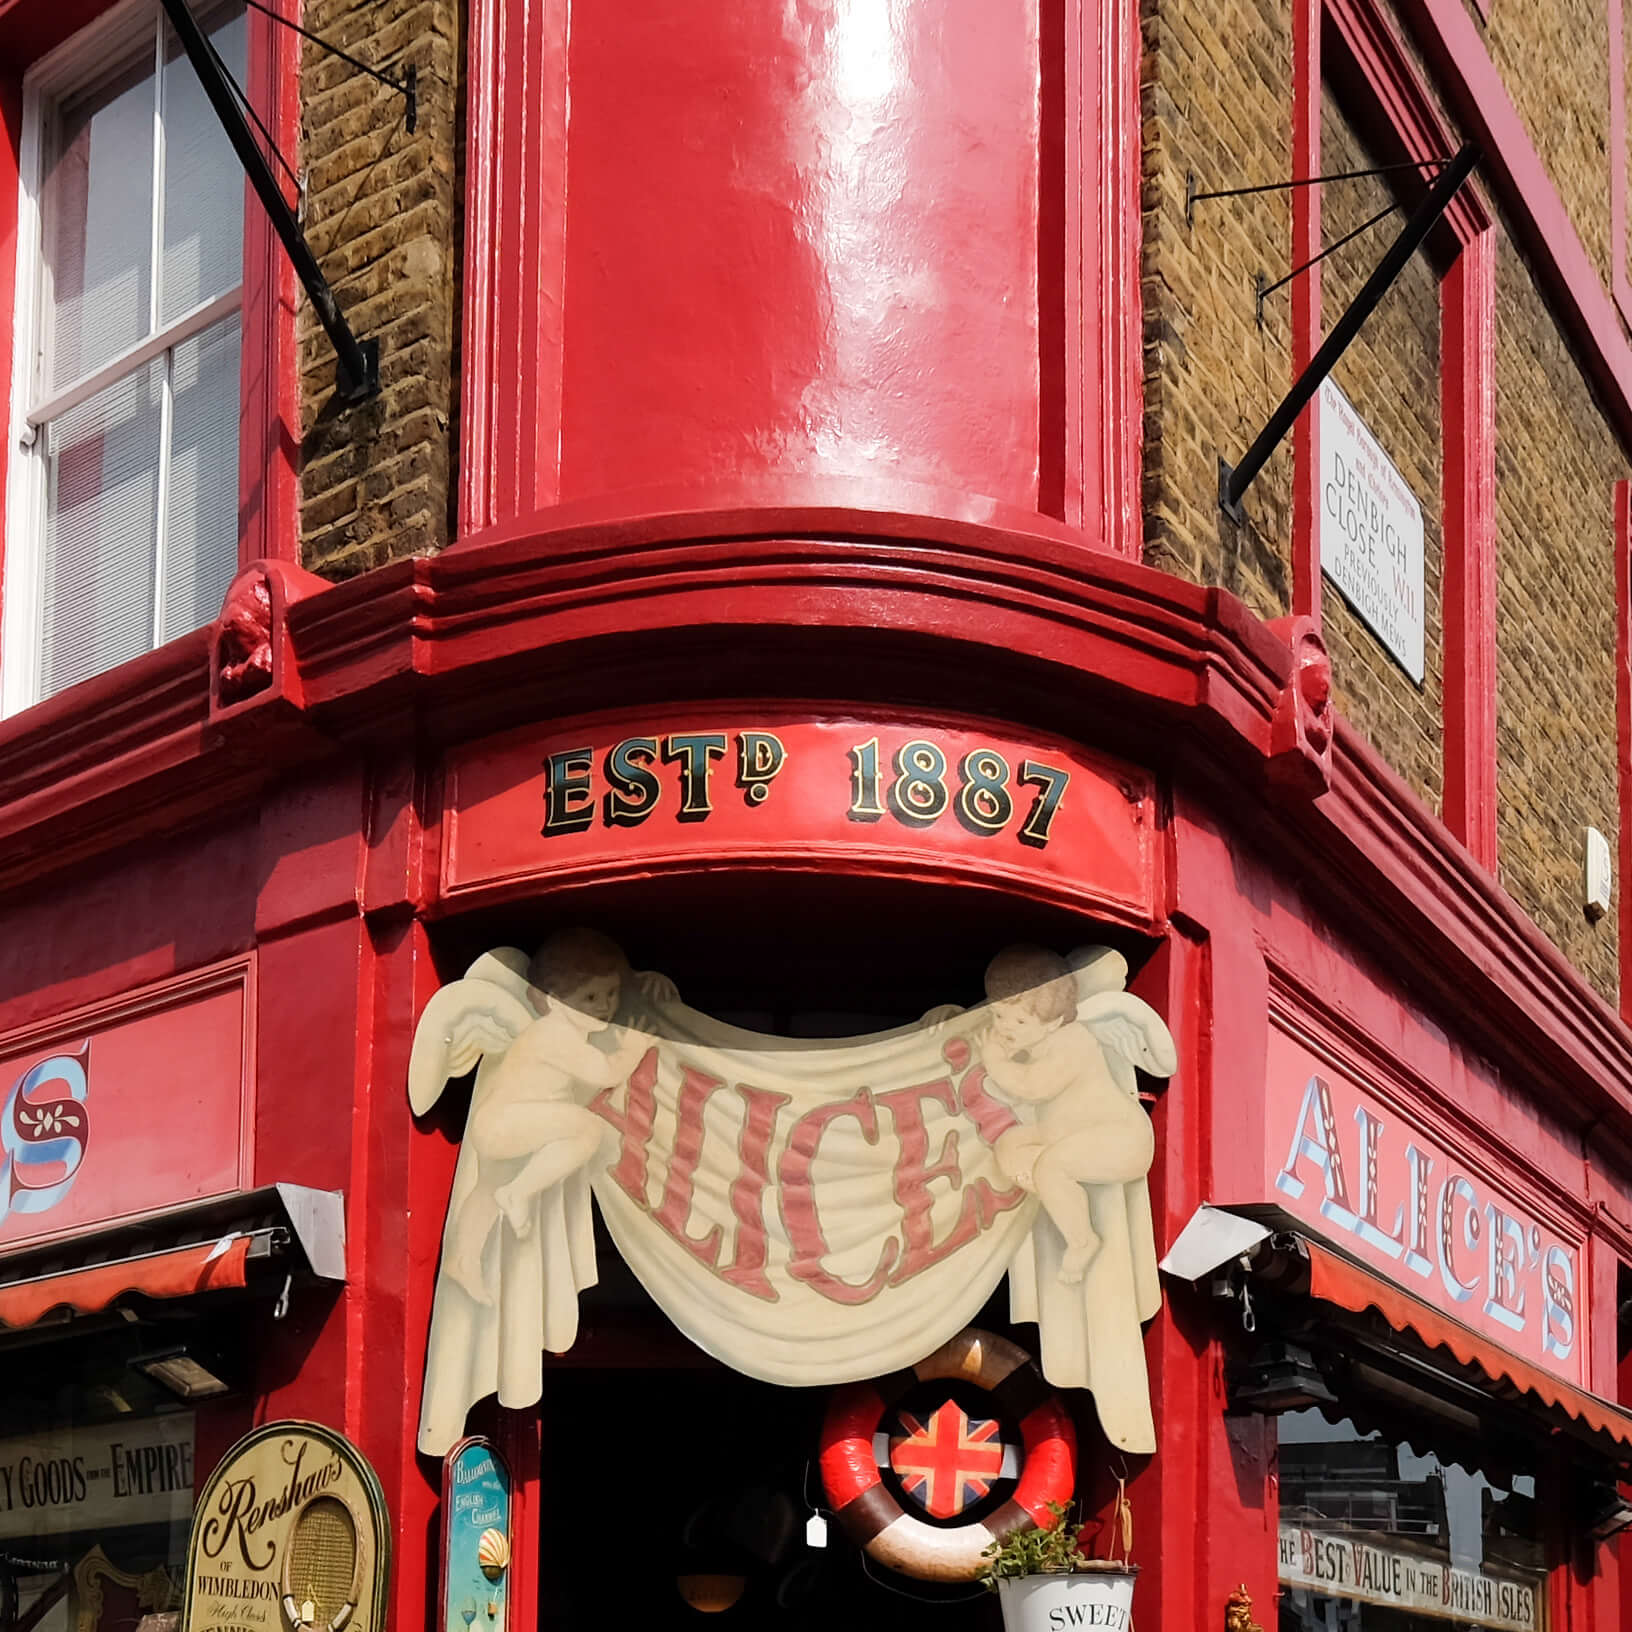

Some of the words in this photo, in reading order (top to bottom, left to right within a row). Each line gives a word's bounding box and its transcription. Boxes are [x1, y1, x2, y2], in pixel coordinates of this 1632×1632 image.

[1335, 451, 1407, 574] DENBIGH
[1334, 556, 1379, 624] DENBIGH
[1381, 614, 1407, 658] MEWS
[1344, 543, 1400, 624] PREVIOUSLY
[846, 736, 1071, 848] 1887
[1274, 1074, 1580, 1362] ALICE'S
[18, 1455, 87, 1510] GOODS
[111, 1441, 194, 1500] EMPIRE
[202, 1438, 343, 1572] Renshaw's
[197, 1575, 282, 1601] WIMBLEDON
[220, 1561, 232, 1572] OF
[1301, 1529, 1347, 1583] BEST
[1351, 1542, 1402, 1596] VALUE
[1406, 1568, 1416, 1592] IN
[1420, 1572, 1438, 1597] THE
[1441, 1565, 1493, 1616] BRITISH
[1497, 1582, 1533, 1625] ISLES
[1049, 1603, 1128, 1632] SWEET
